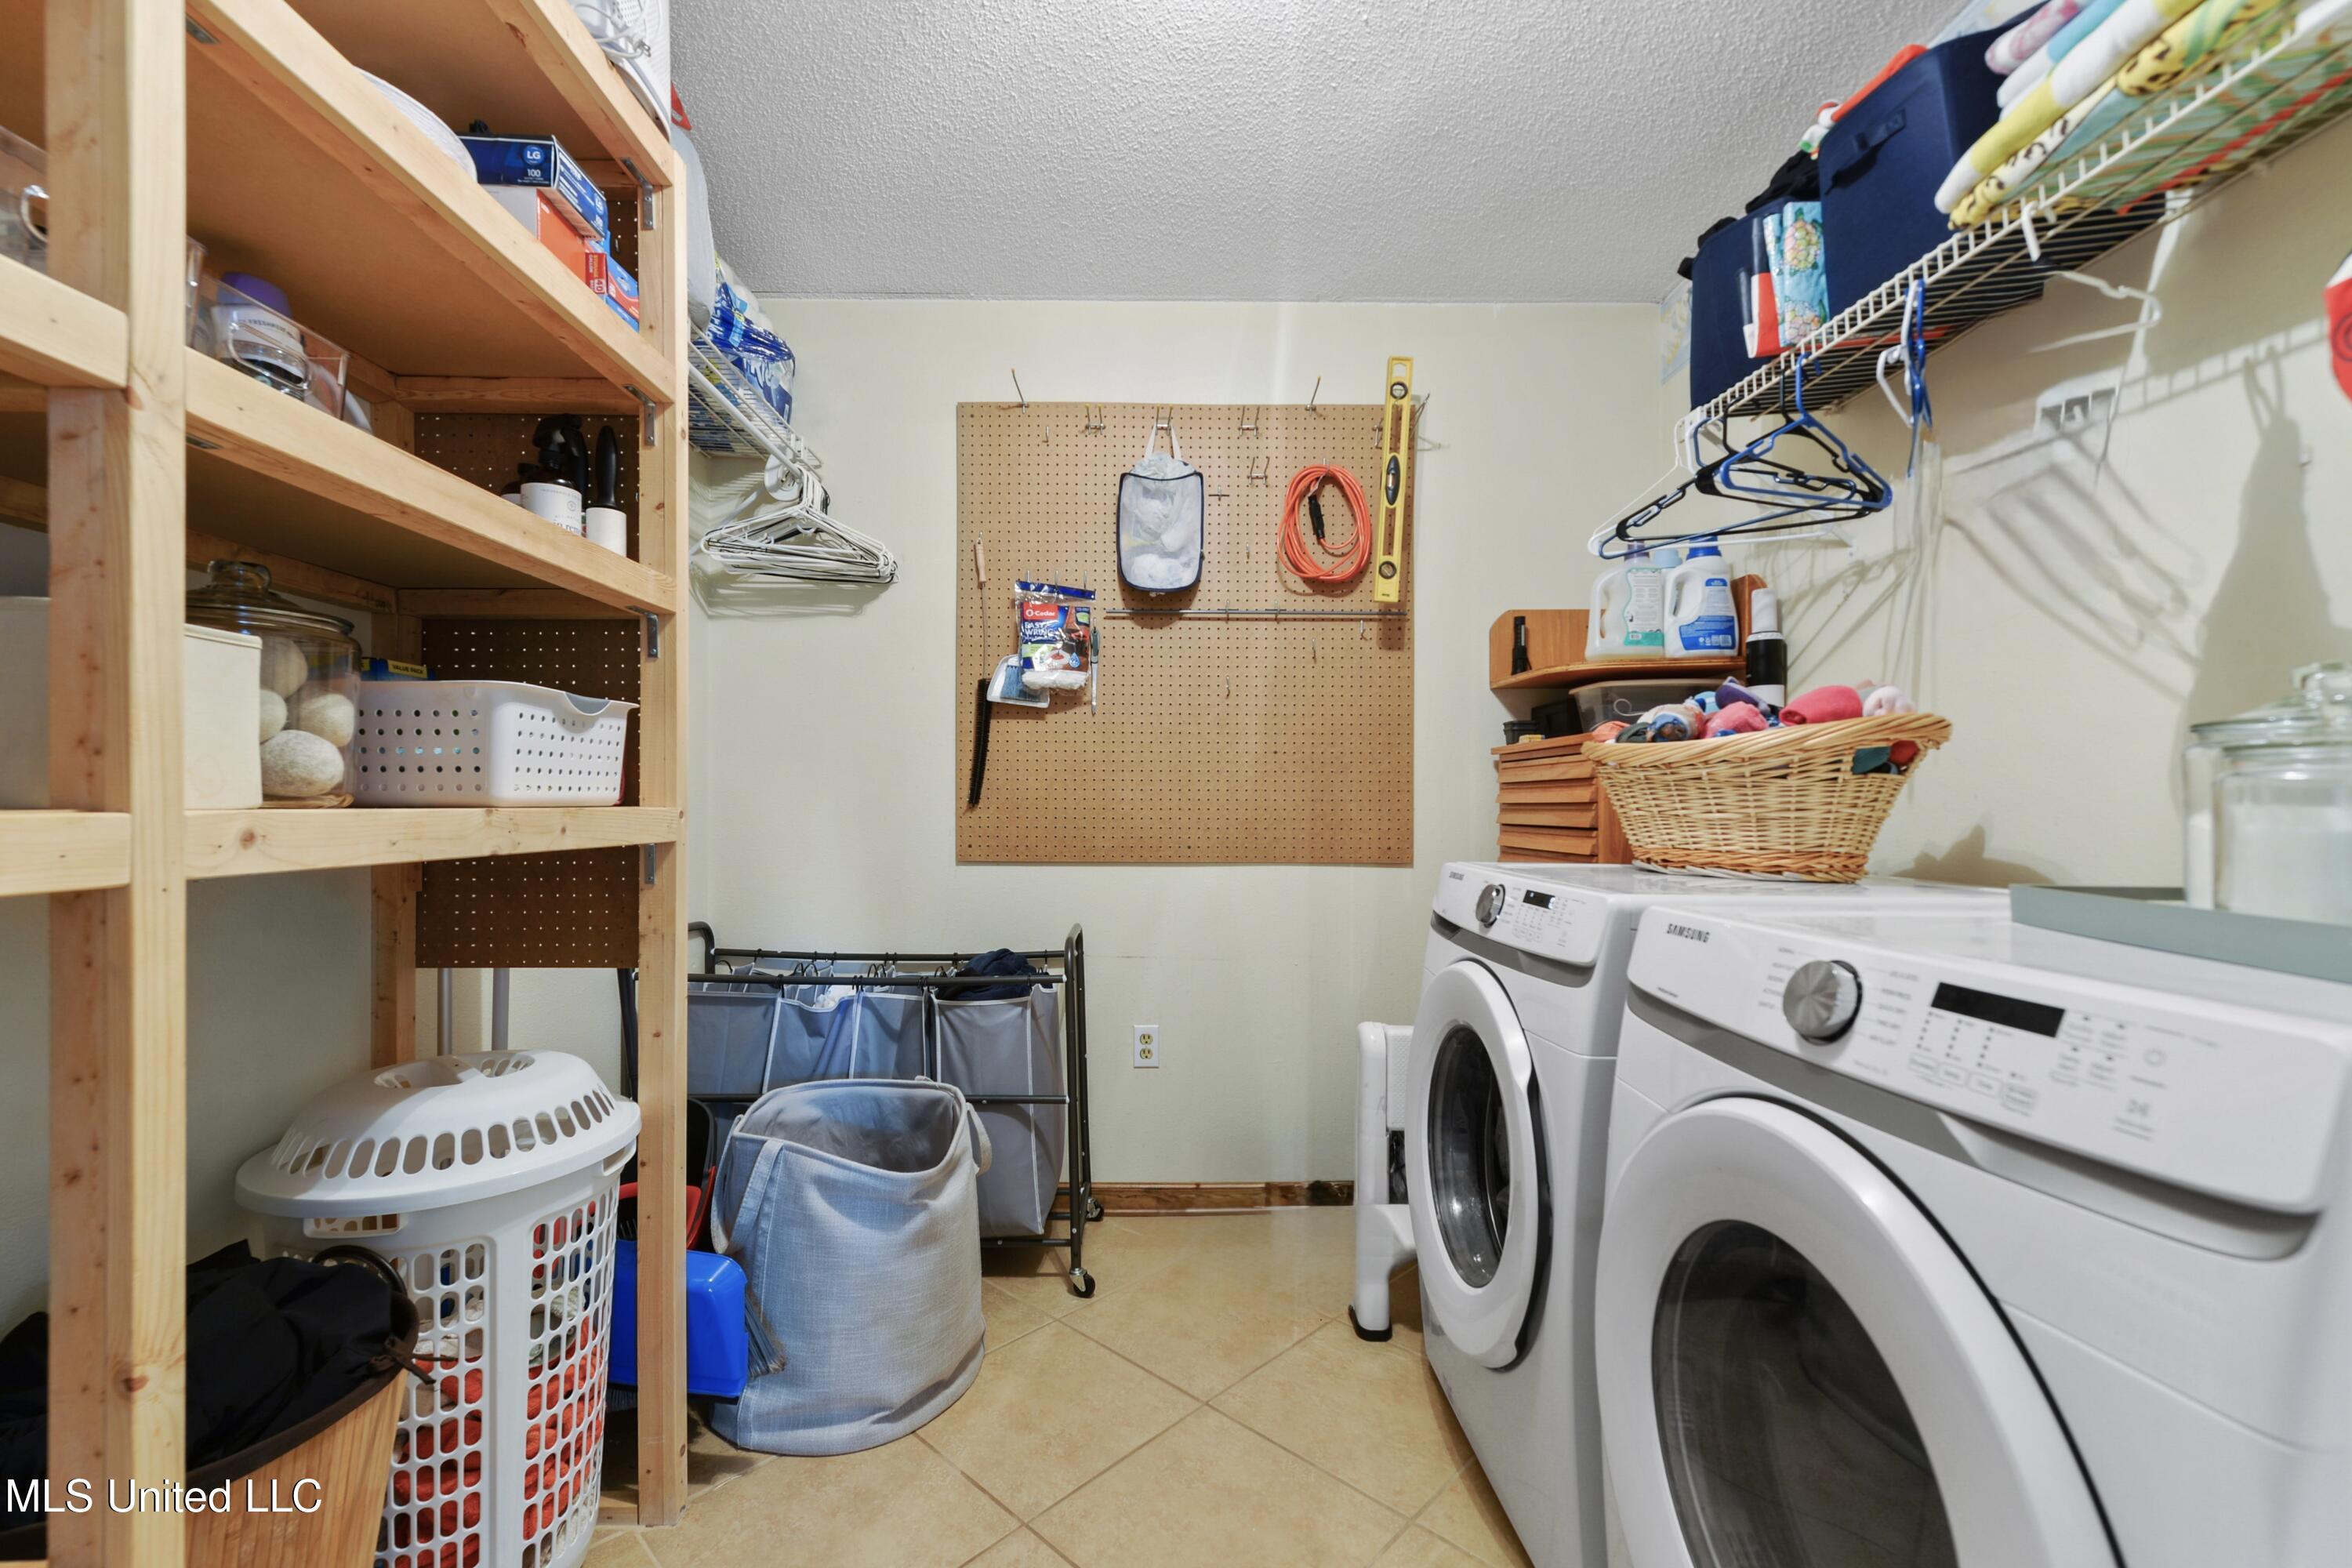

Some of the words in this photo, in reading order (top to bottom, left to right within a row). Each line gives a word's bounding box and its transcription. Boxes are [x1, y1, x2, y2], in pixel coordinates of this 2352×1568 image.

[526, 150, 541, 160] LG
[527, 169, 541, 177] 100
[1666, 923, 1711, 943] SAMSUNG
